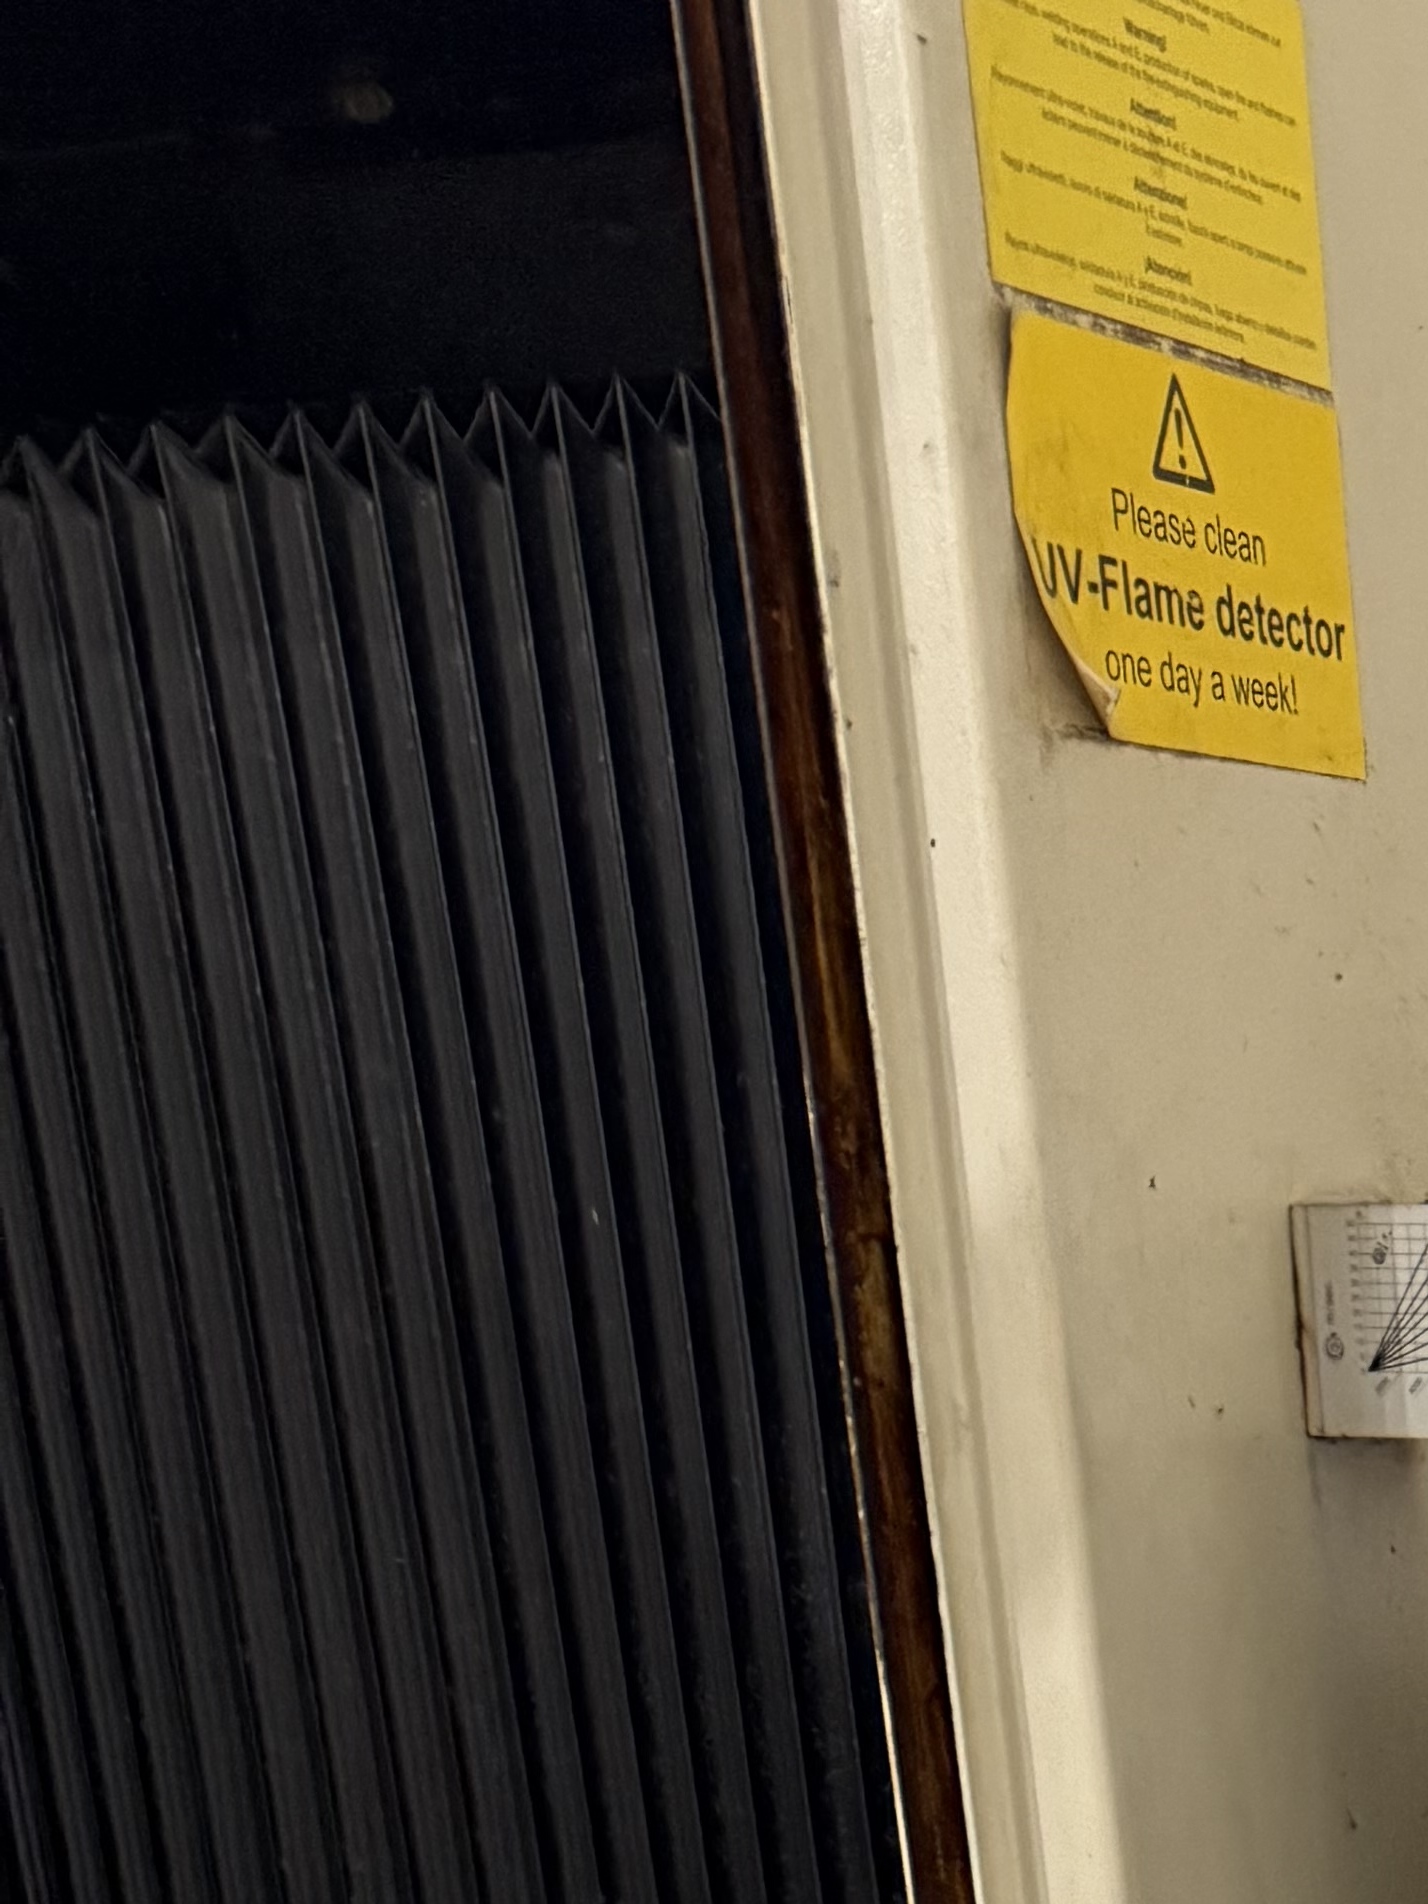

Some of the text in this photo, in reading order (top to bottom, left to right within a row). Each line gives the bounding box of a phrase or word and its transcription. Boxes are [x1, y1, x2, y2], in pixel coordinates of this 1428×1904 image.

[1111, 487, 1267, 567] Please clean
[1031, 537, 1346, 662] UV-Flame detector
[1105, 649, 1299, 716] one day a week!
